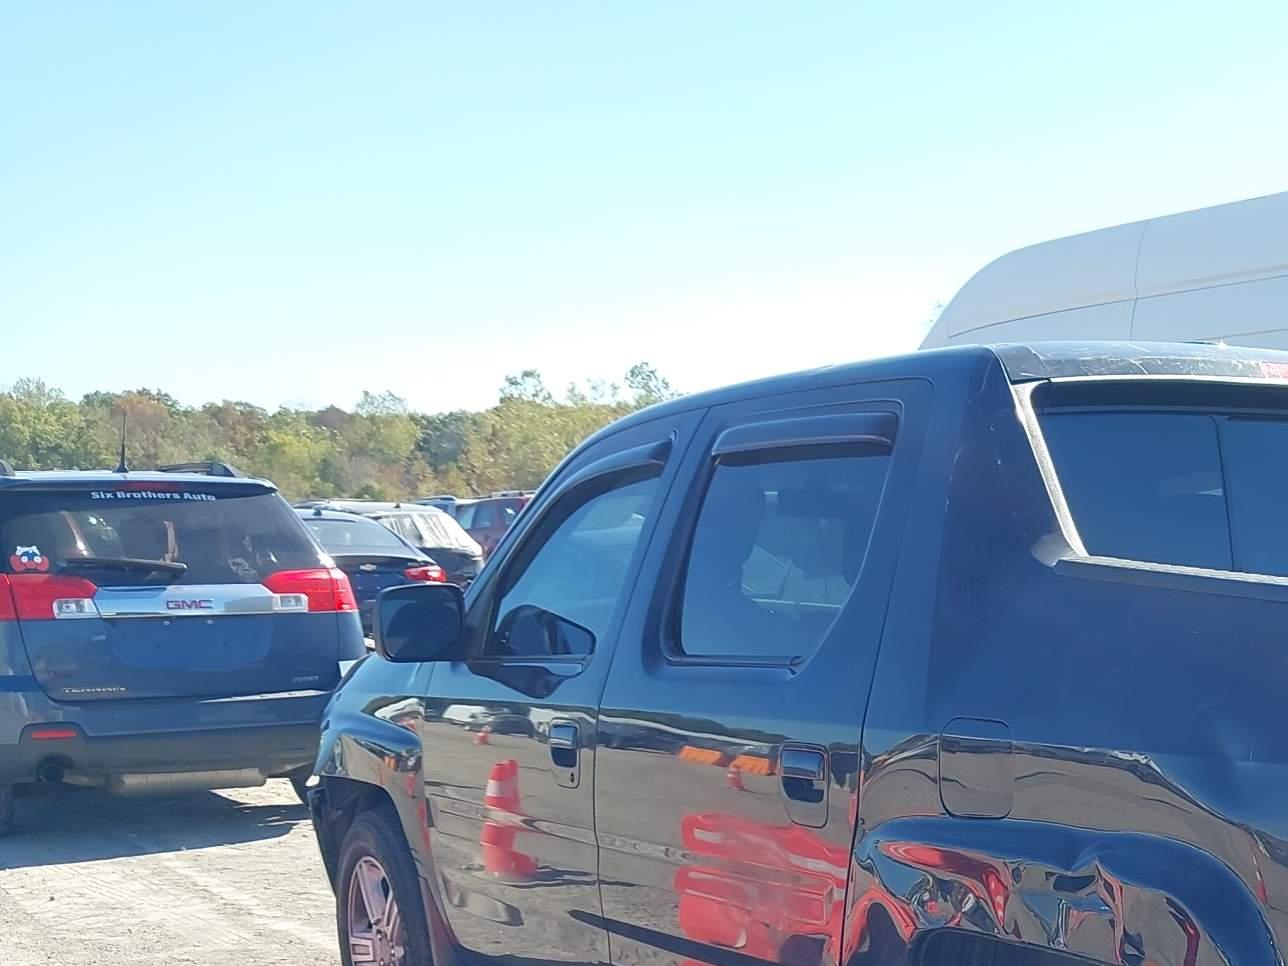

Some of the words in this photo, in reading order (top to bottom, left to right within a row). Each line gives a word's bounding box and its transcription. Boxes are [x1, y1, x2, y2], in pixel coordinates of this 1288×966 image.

[91, 491, 114, 499] Six
[116, 491, 181, 500] Brothers
[183, 492, 216, 501] Auto
[166, 599, 213, 610] GMC
